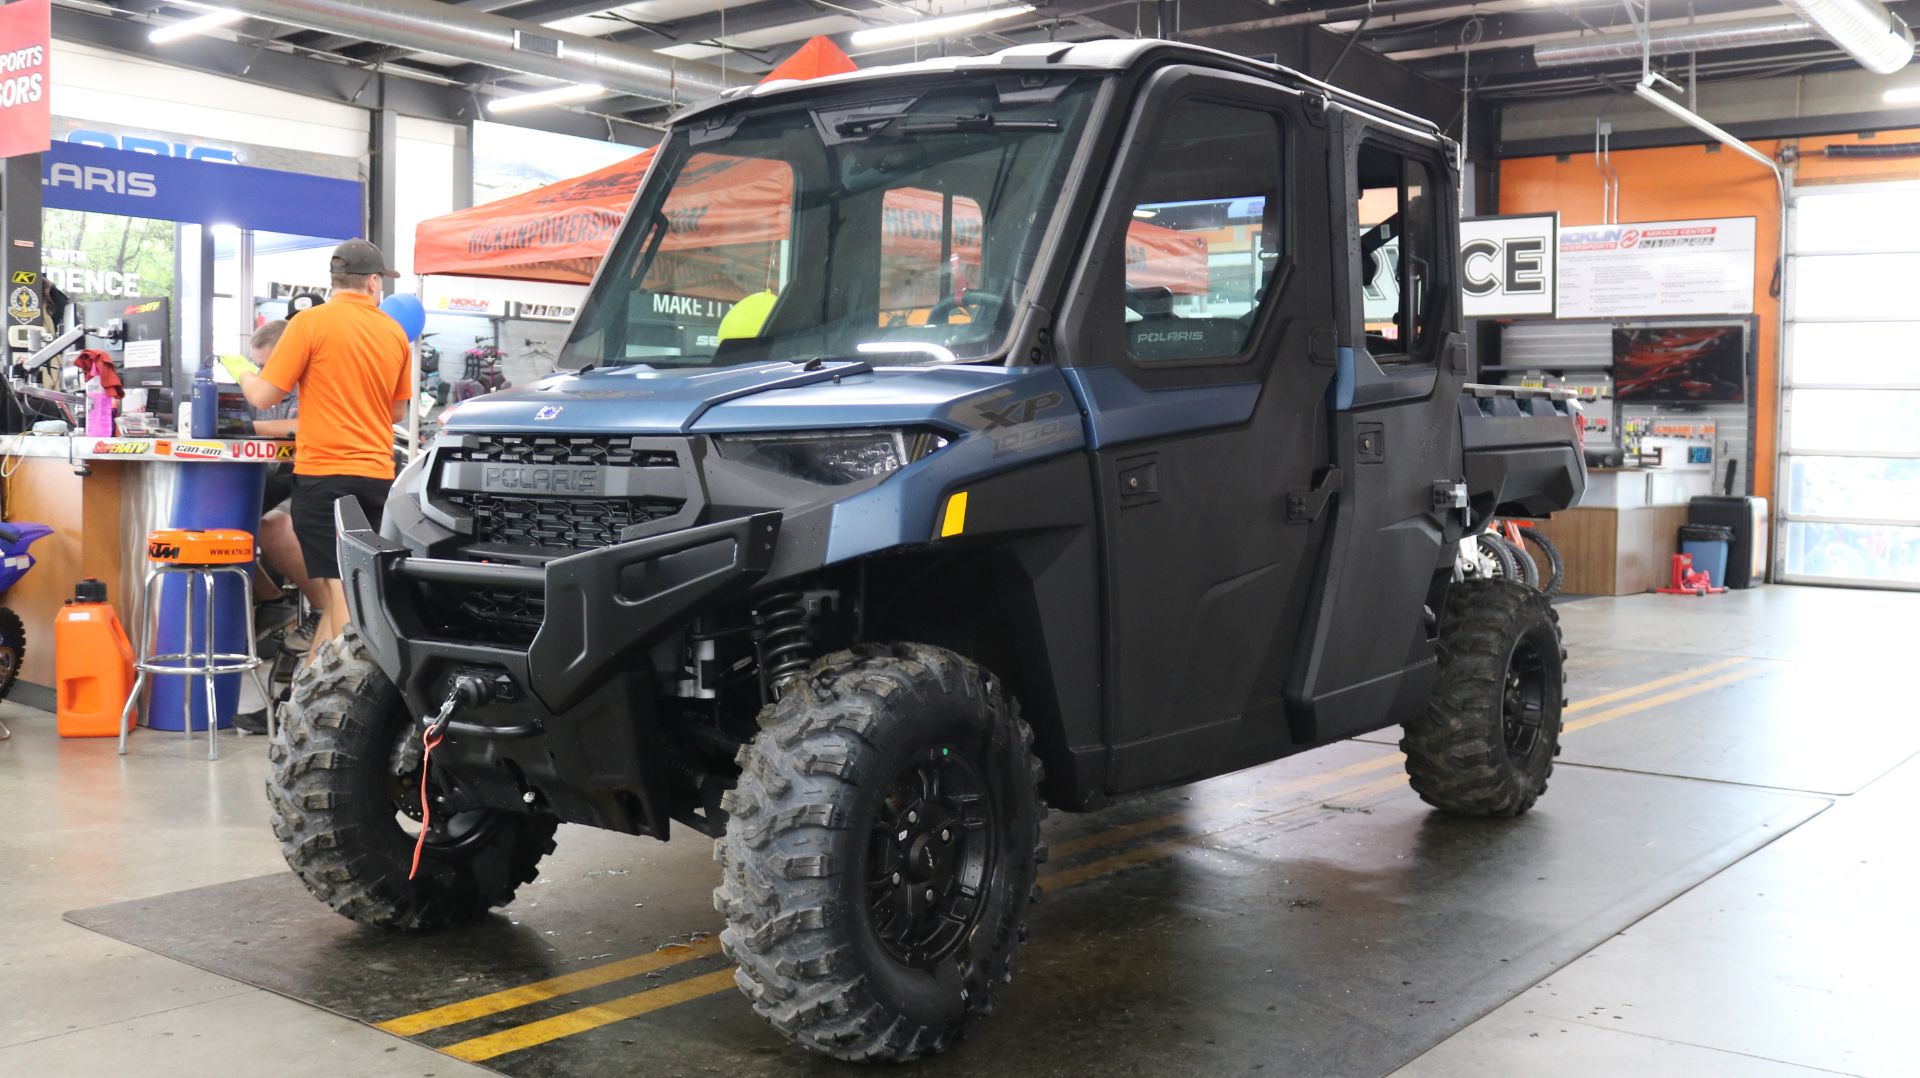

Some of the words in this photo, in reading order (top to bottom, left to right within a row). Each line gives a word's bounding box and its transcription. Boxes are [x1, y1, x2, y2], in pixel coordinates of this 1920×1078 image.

[653, 293, 702, 316] MAKE
[1137, 332, 1204, 343] POLARIS
[974, 390, 1062, 435] XP
[486, 467, 598, 491] POLARIS
[148, 543, 180, 559] KTM
